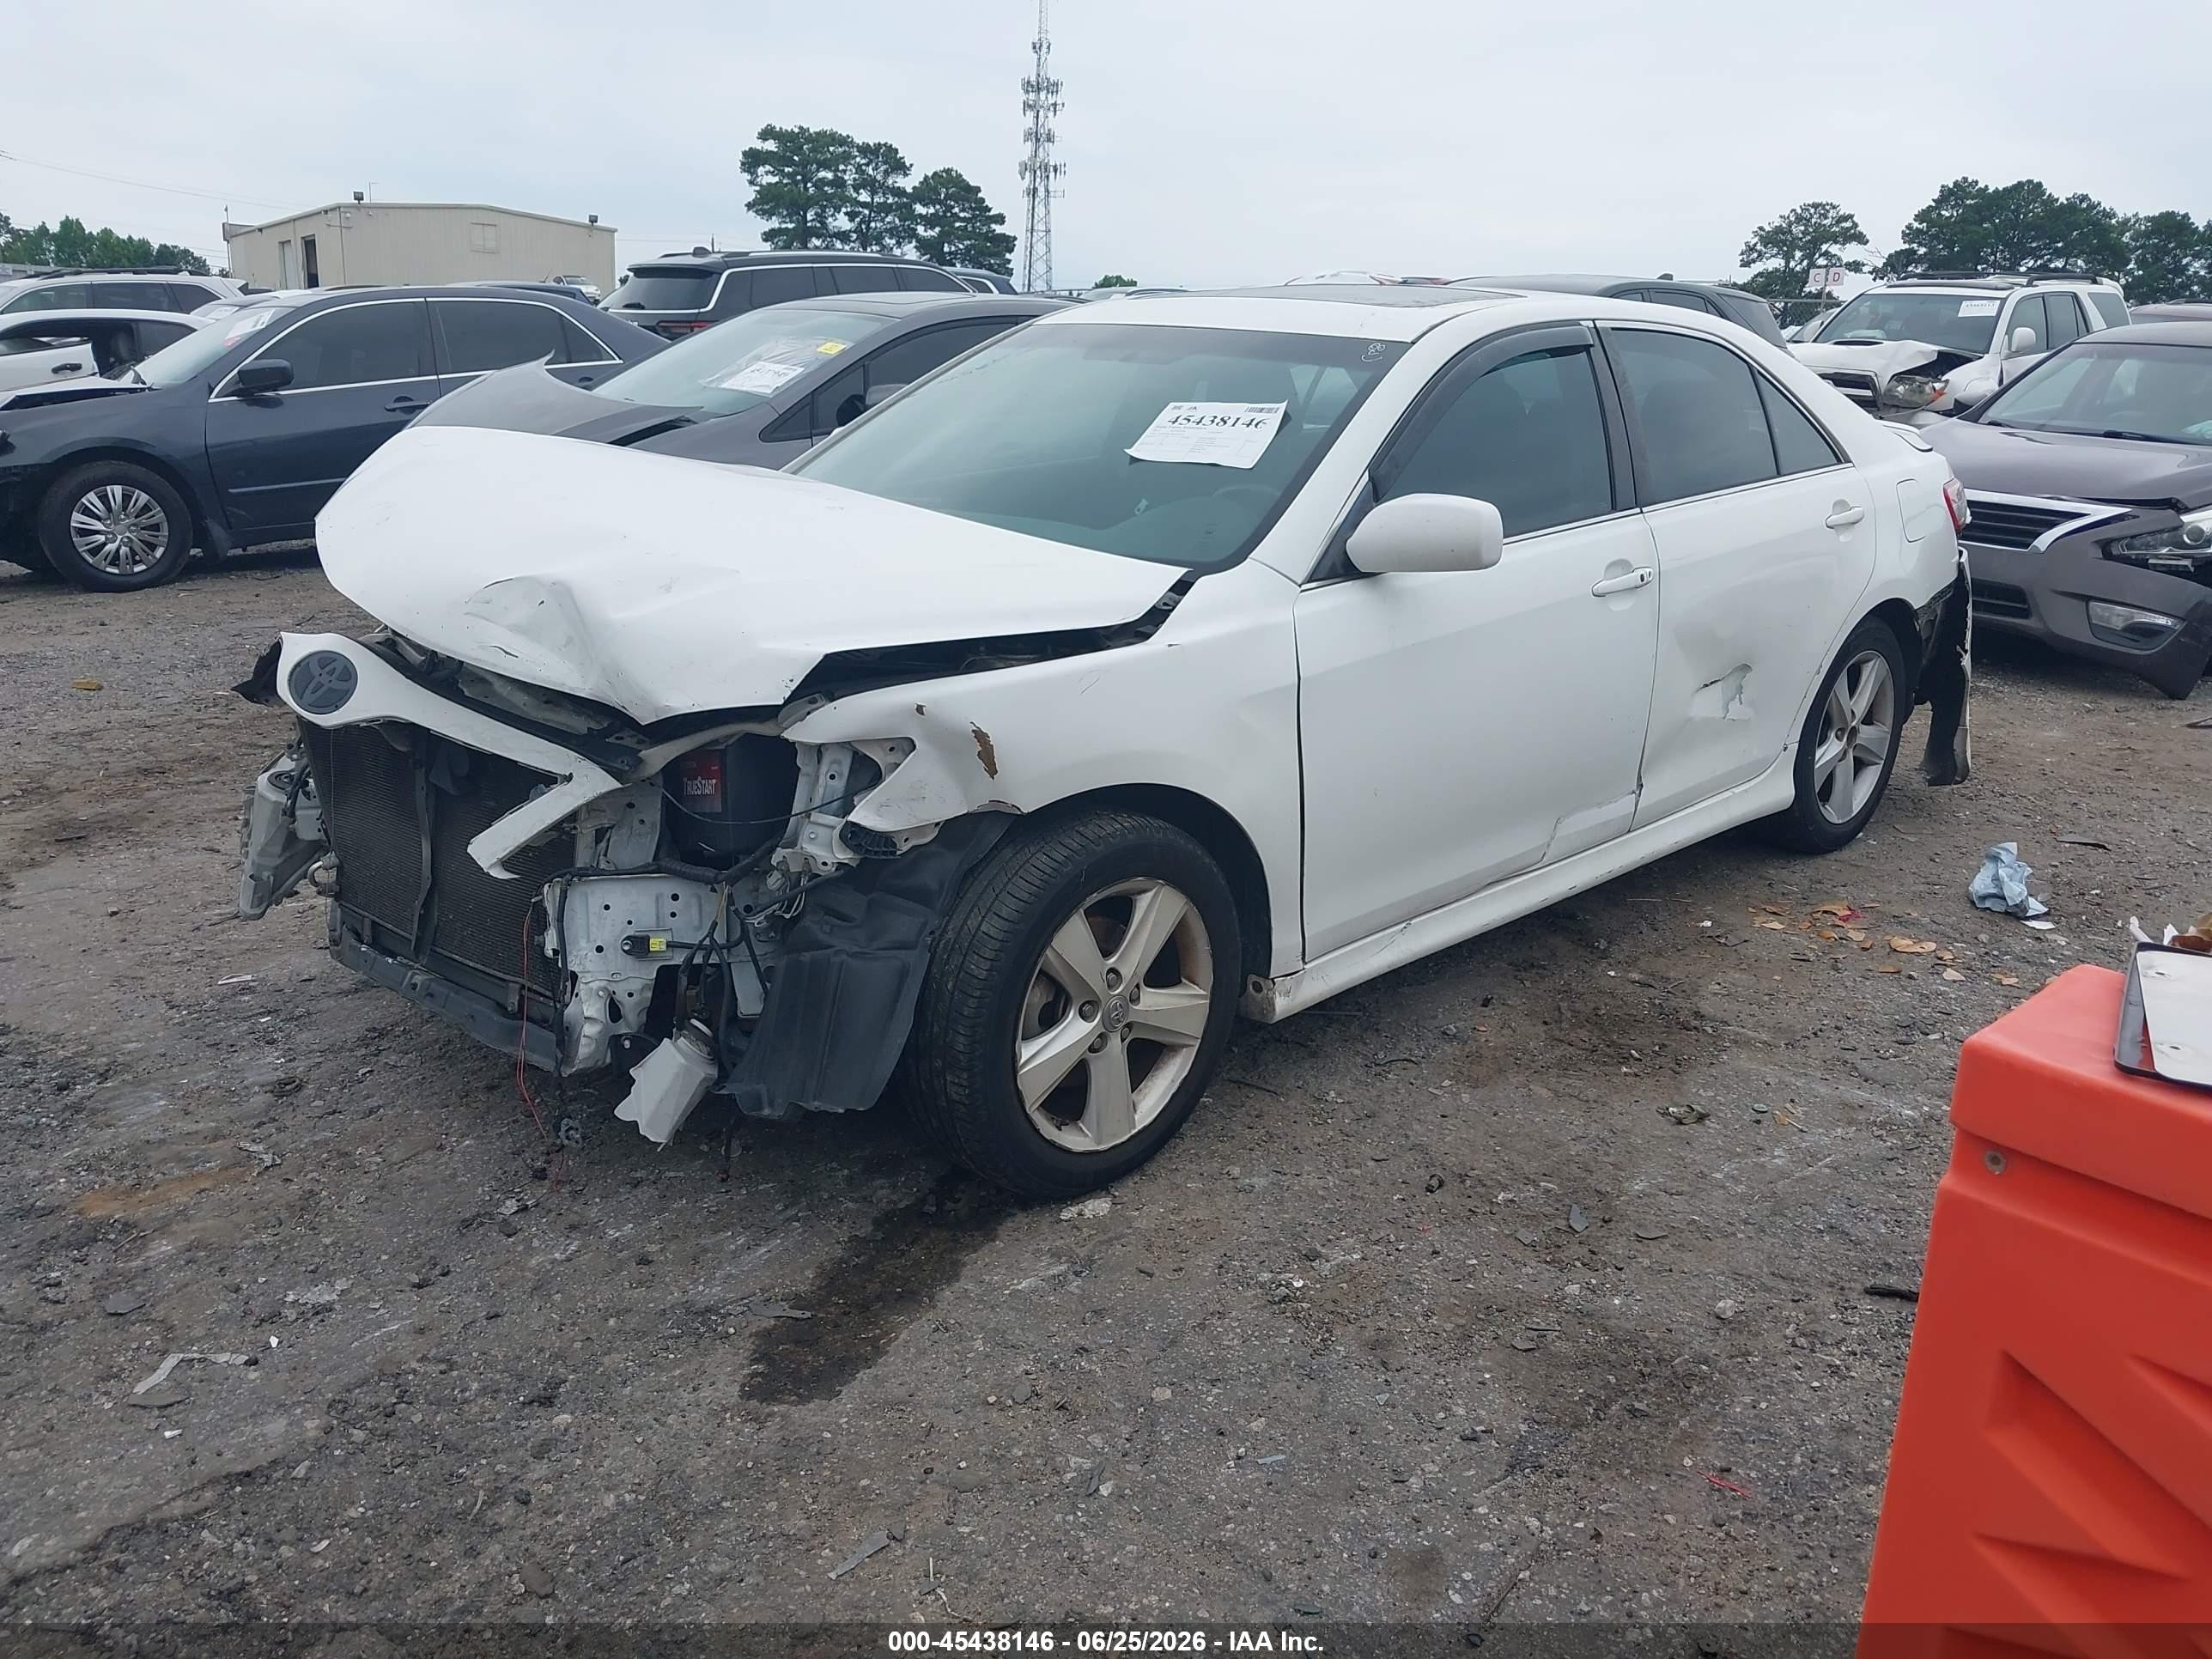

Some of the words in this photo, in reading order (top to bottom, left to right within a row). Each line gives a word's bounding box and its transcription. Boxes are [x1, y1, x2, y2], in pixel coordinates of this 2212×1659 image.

[1813, 272, 1821, 283] C
[1832, 271, 1841, 283] D
[1167, 414, 1271, 430] 45438146
